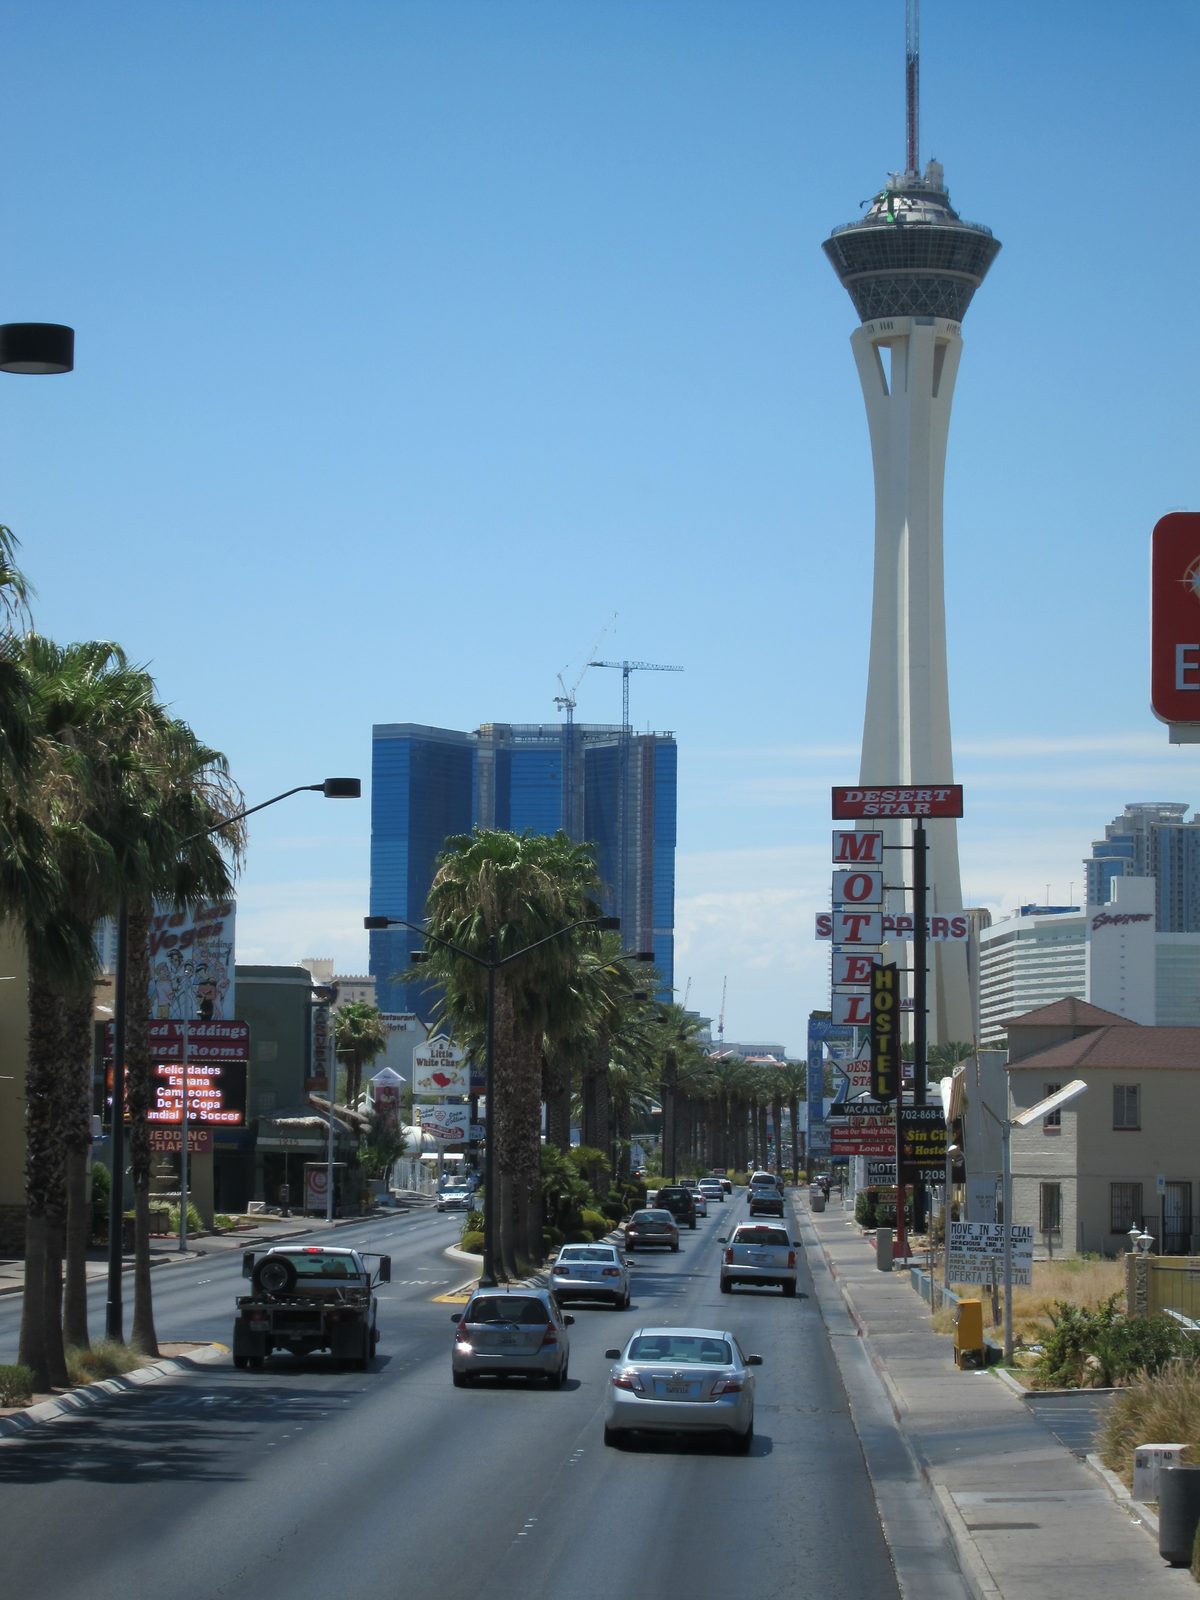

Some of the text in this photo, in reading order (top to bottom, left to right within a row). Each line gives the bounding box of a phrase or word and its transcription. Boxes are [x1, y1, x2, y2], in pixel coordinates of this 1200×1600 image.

[844, 789, 952, 803] DESERT
[862, 803, 932, 815] STAR
[835, 832, 881, 1024] MOTEL
[174, 1024, 247, 1039] Weddings
[874, 970, 894, 1095] HOSTEL
[187, 1044, 244, 1056] Rooms
[430, 1050, 453, 1058] Little
[416, 1058, 460, 1069] White Chap
[158, 1064, 221, 1075] Felicdades
[169, 1076, 210, 1086] Esana
[852, 1076, 871, 1086] STA
[157, 1099, 172, 1108] De
[192, 1099, 221, 1109] Copa
[843, 1105, 889, 1114] VACANCY
[147, 1110, 179, 1120] undial
[200, 1111, 240, 1121] Soccer
[149, 1130, 208, 1141] EDDNG
[834, 1128, 849, 1136] Check
[906, 1129, 928, 1141] Sin
[858, 1145, 884, 1153] Local
[869, 1163, 896, 1174] MOTE
[869, 1176, 896, 1184] ENTRAN
[919, 1170, 946, 1180] 1208
[951, 1223, 1033, 1238] MOVE IN SPCIAL
[948, 1271, 982, 1283] OFERTA
